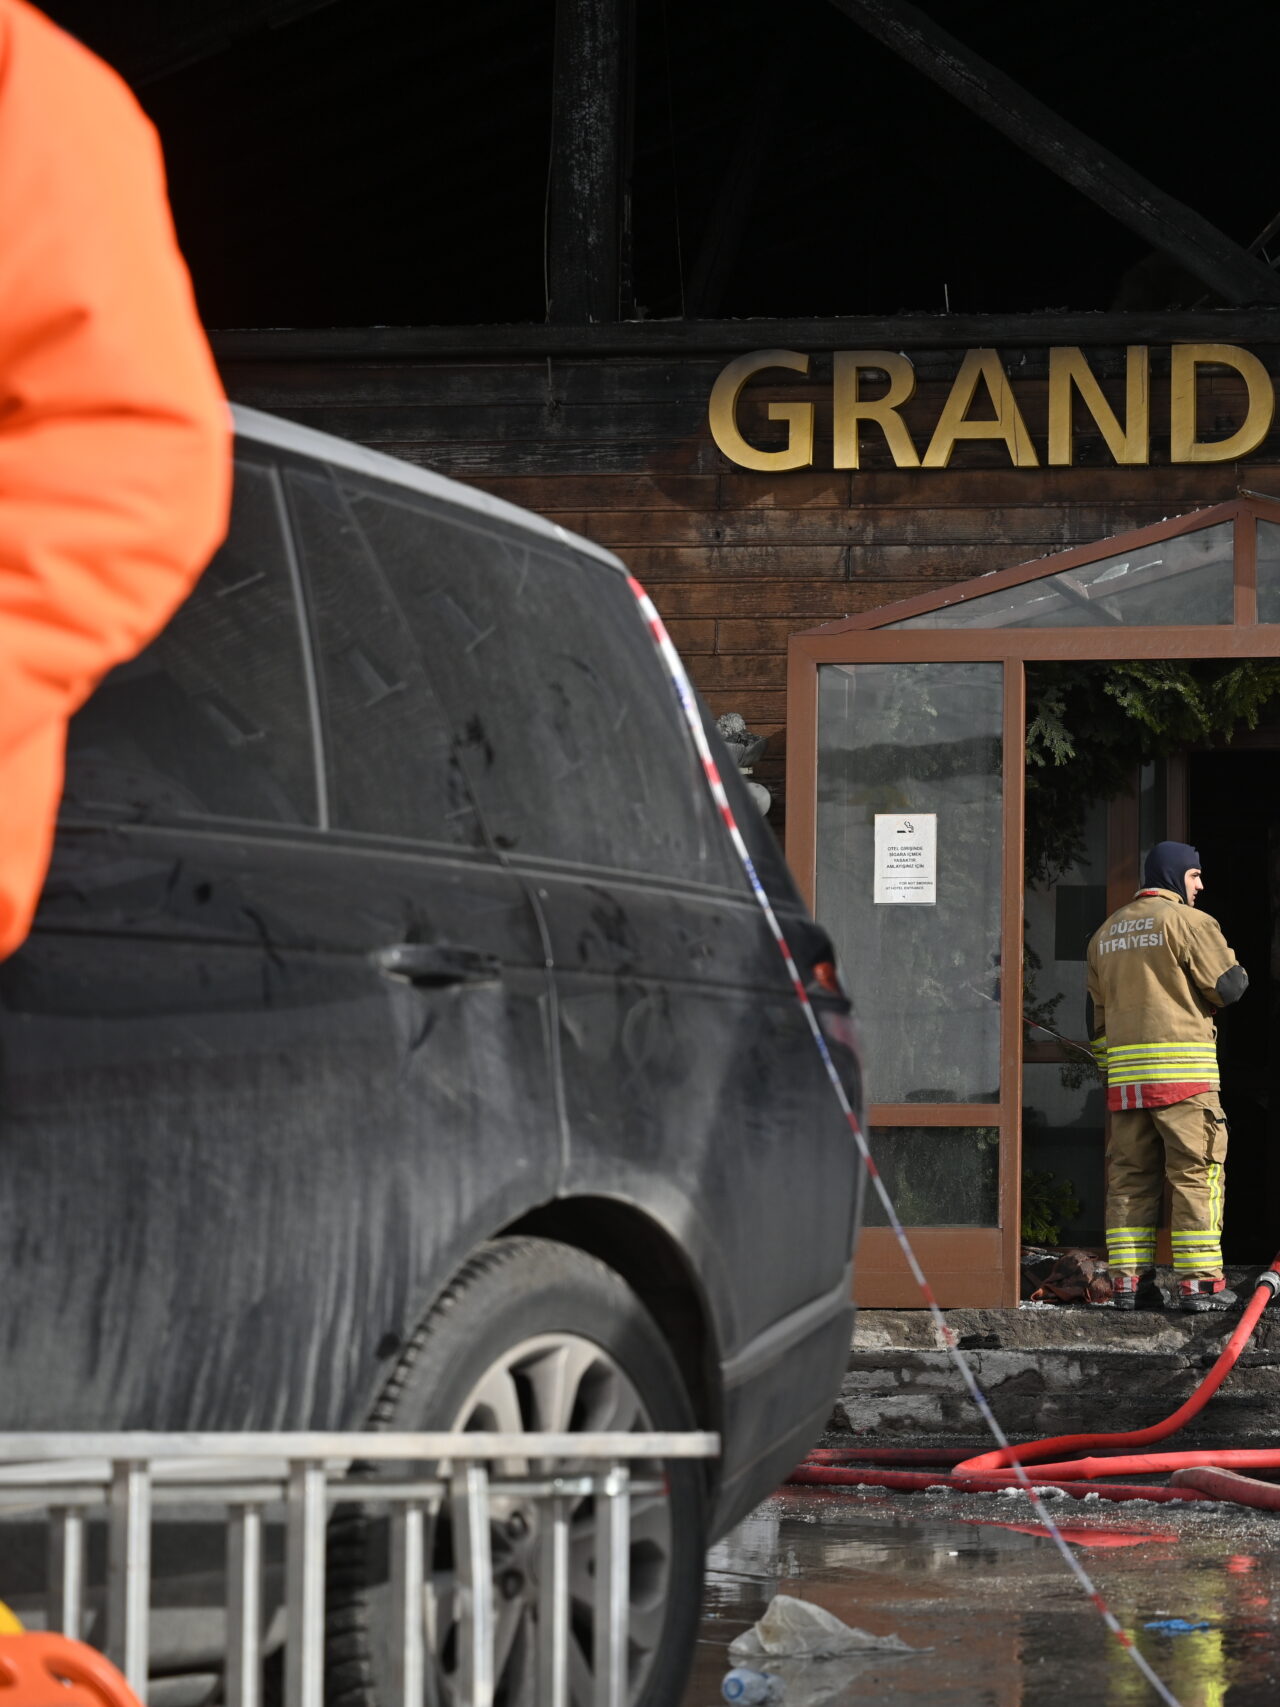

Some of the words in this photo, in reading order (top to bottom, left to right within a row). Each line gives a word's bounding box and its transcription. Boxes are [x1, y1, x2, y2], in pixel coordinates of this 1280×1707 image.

[708, 343, 1277, 471] GRAND
[1110, 918, 1154, 936] DÜZCE
[1099, 931, 1163, 956] İTFAİYESİ
